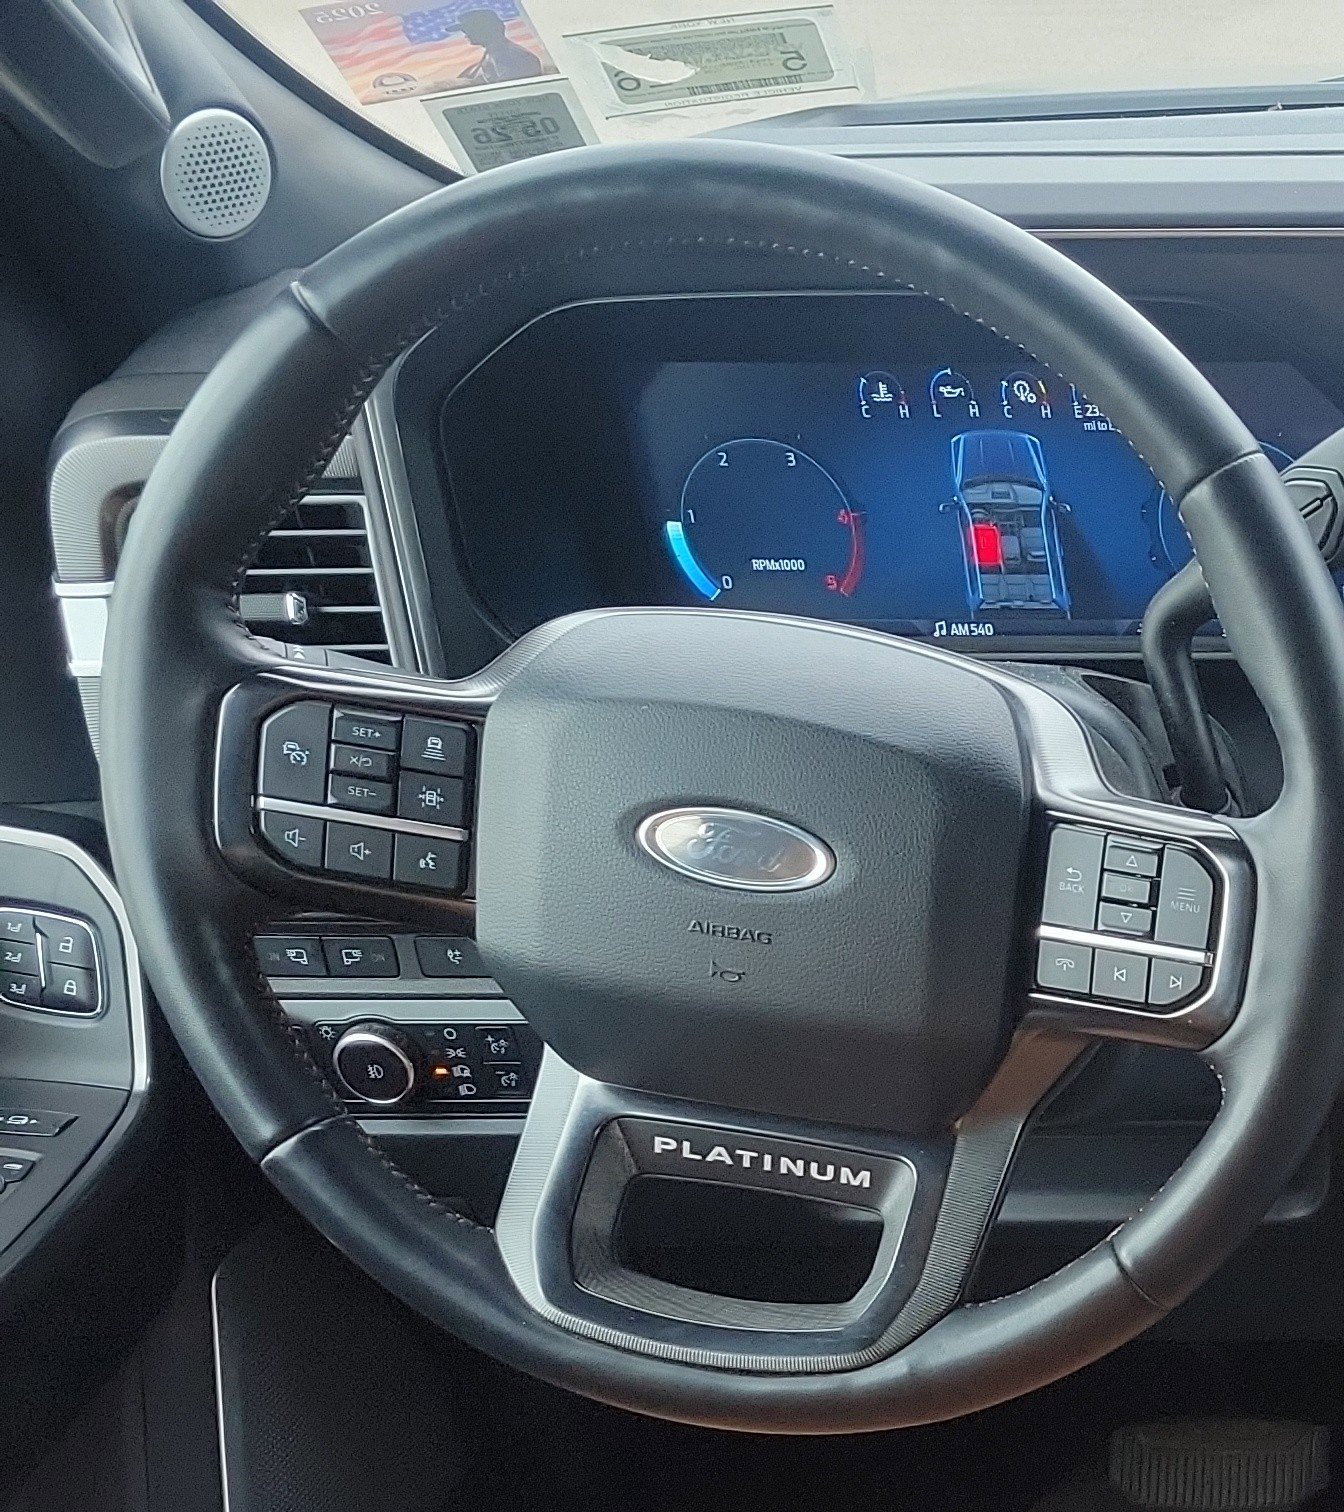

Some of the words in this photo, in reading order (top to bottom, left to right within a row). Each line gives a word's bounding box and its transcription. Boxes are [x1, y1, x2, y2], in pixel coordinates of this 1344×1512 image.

[899, 405, 910, 419] H
[968, 404, 980, 418] H
[1041, 404, 1052, 419] H
[717, 452, 729, 467] 2
[785, 452, 796, 467] 3
[687, 509, 695, 524] 1
[751, 559, 806, 571] RPMx1000
[721, 575, 733, 590] 0
[951, 624, 969, 637] AM
[970, 624, 994, 637] 540
[1058, 881, 1085, 895] BACK
[1170, 901, 1201, 914] MENU
[653, 1136, 872, 1189] PLATINUM
